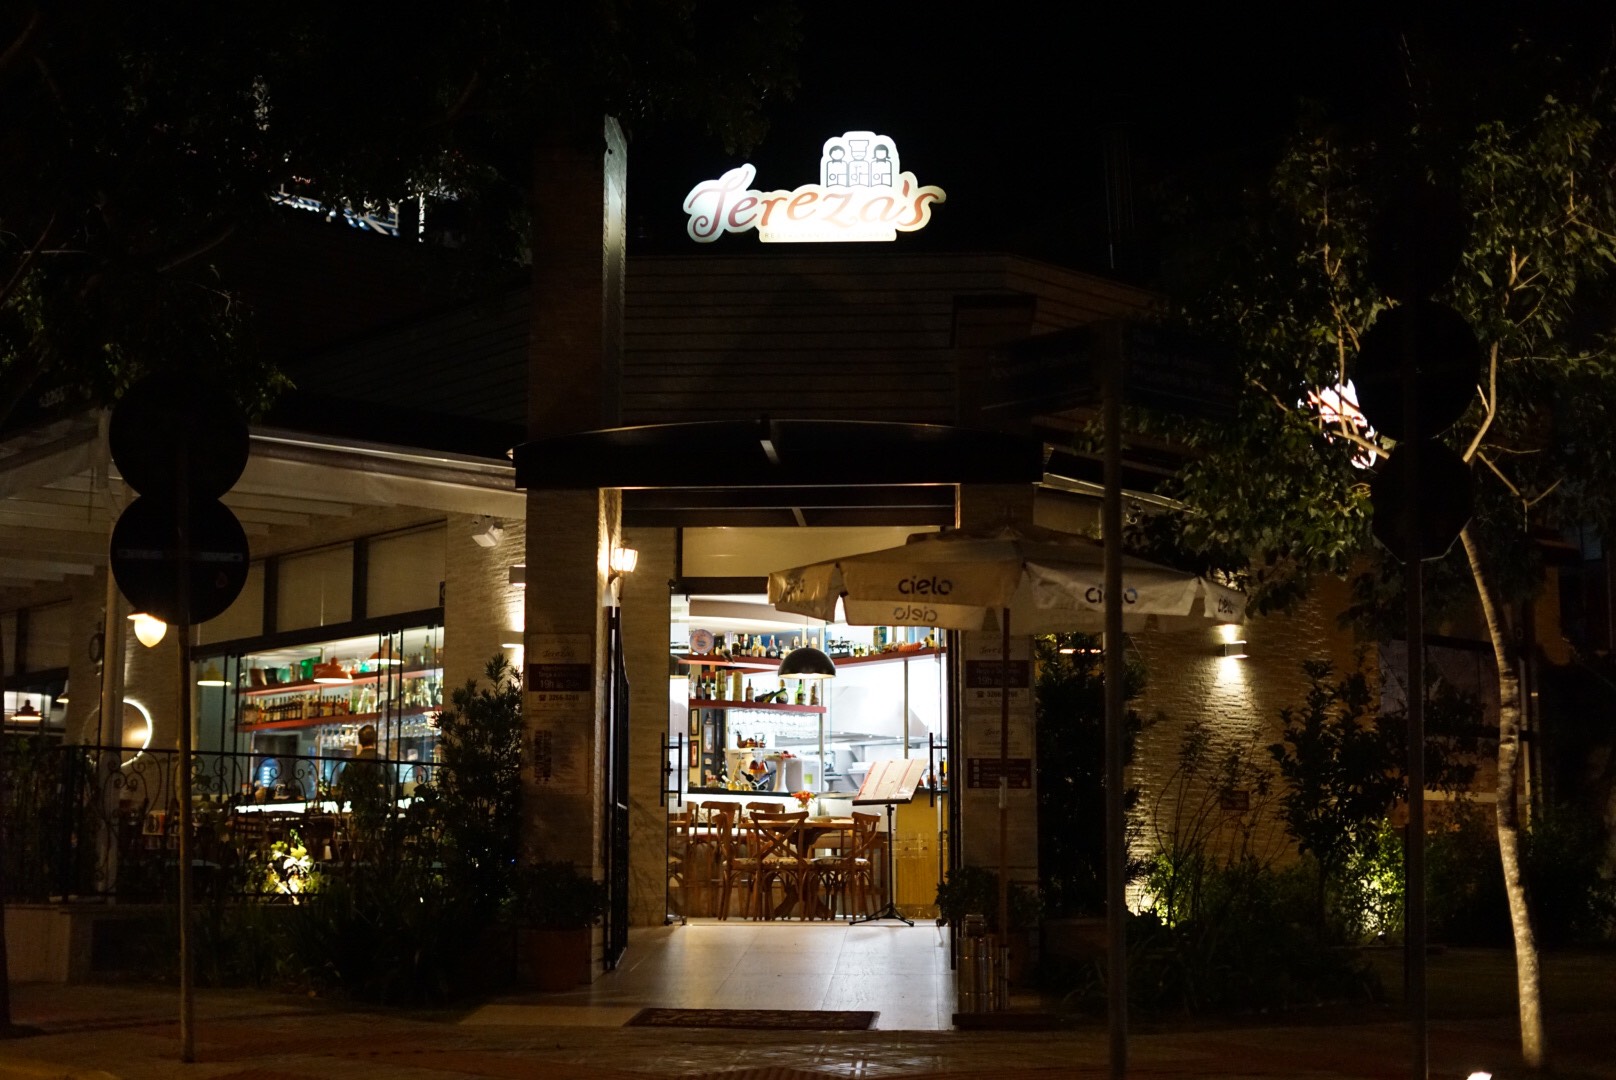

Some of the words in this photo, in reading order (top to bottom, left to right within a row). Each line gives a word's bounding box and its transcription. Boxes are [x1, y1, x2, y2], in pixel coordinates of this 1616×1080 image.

[688, 171, 939, 238] Tereza's
[898, 575, 953, 596] cielo
[1085, 583, 1138, 604] cio
